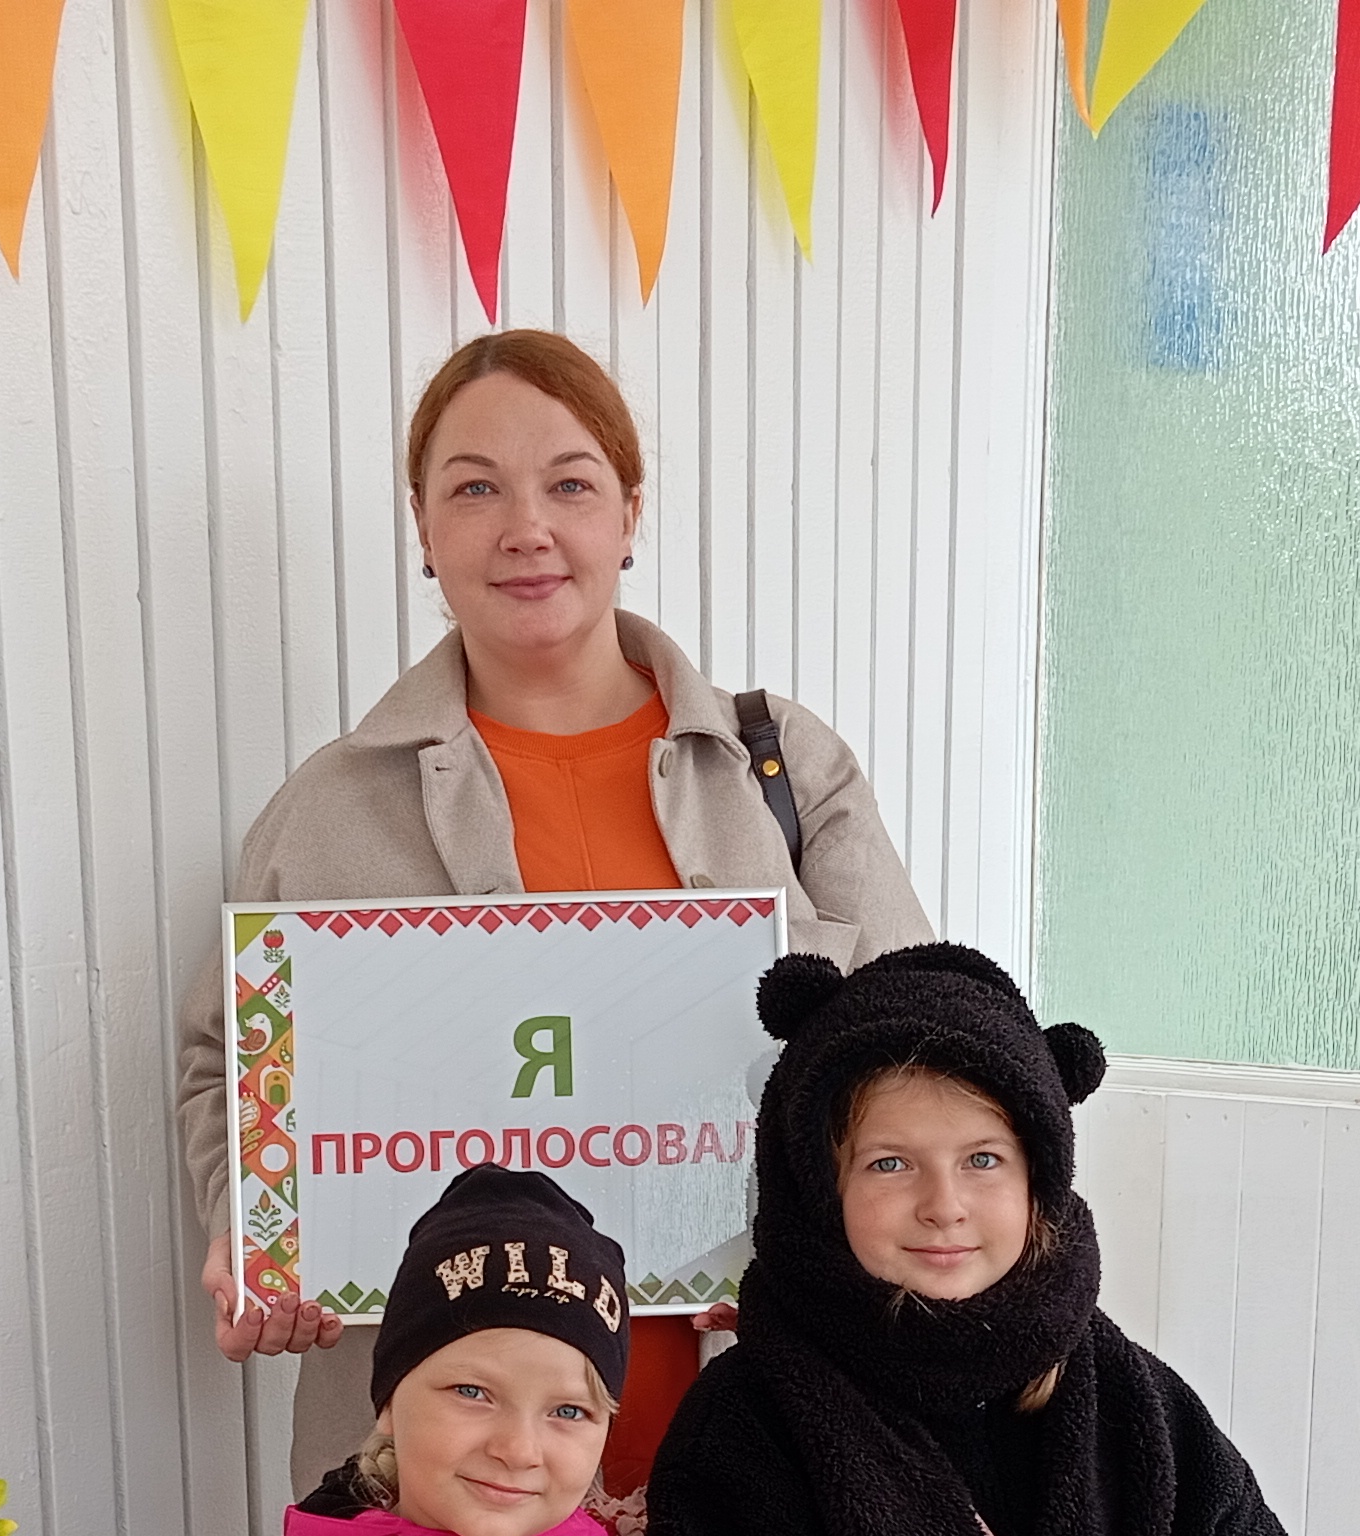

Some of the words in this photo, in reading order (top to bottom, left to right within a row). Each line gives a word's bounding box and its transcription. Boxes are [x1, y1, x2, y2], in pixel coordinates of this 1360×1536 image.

[510, 1015, 574, 1098] Я
[310, 1119, 759, 1175] ПРОГОЛОСОВАЛ
[434, 1241, 622, 1334] WILD
